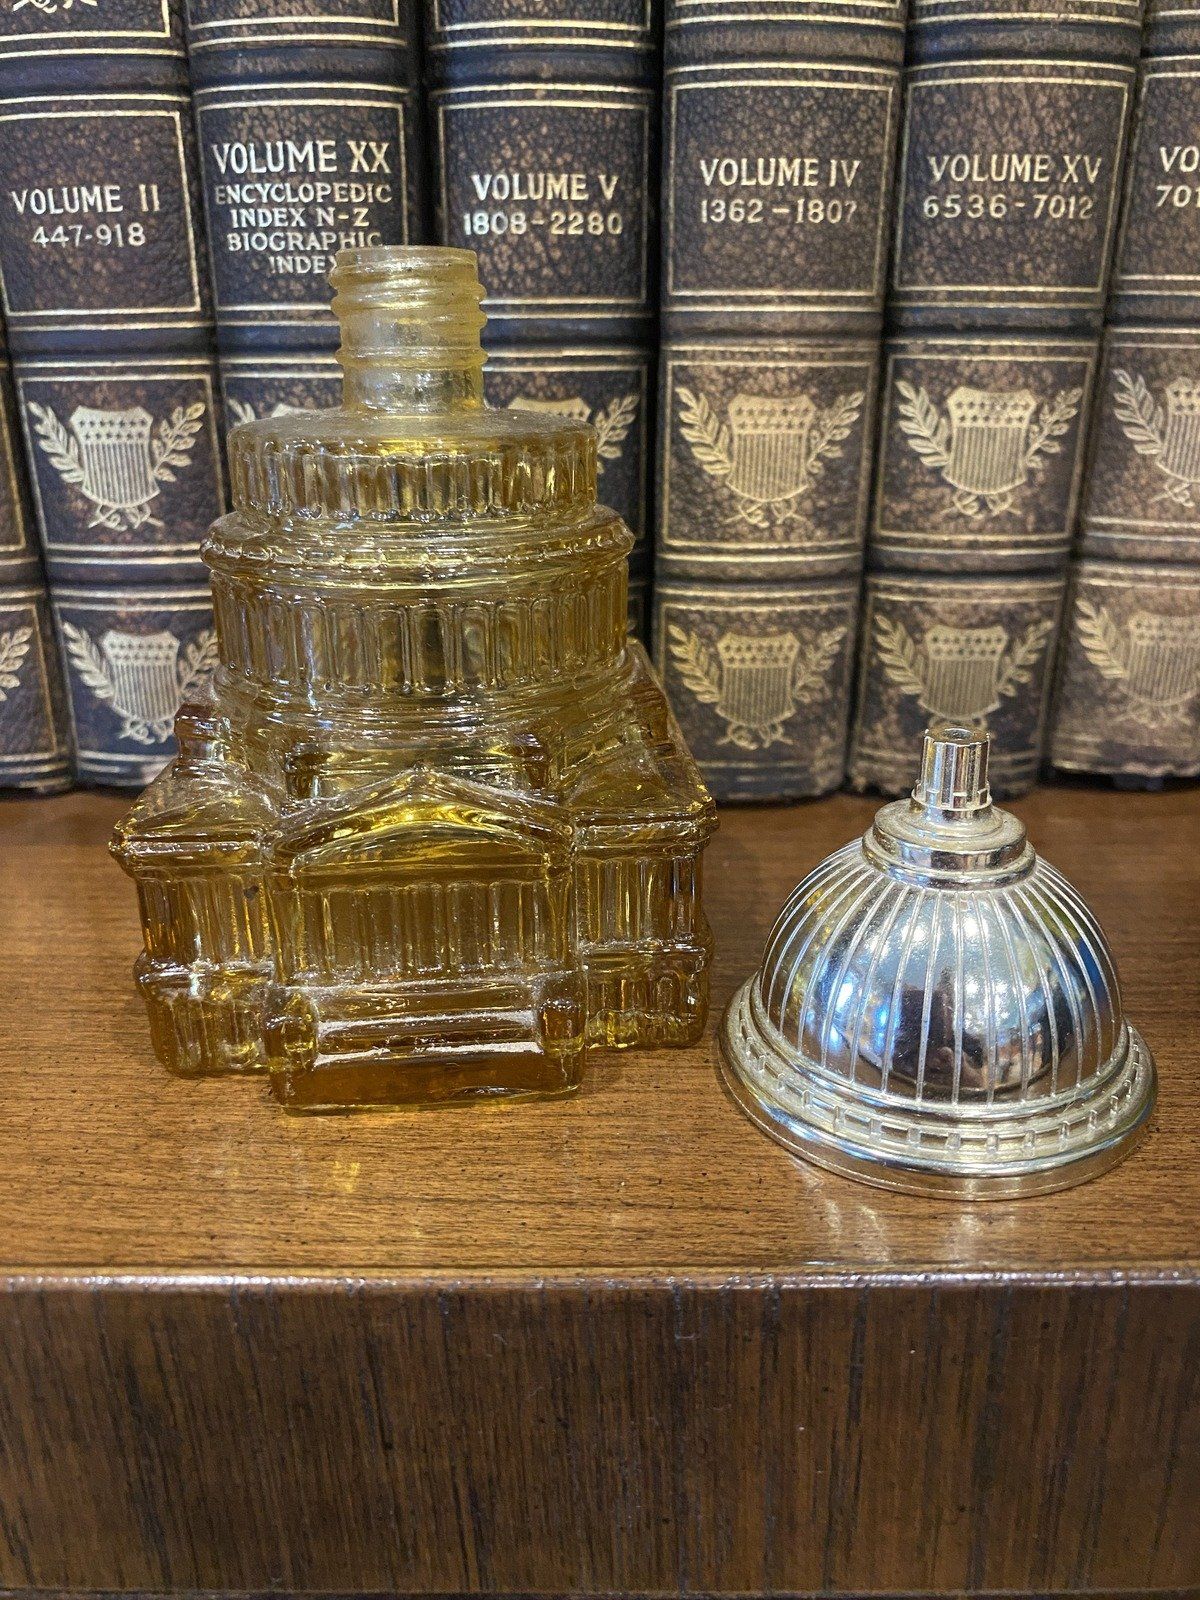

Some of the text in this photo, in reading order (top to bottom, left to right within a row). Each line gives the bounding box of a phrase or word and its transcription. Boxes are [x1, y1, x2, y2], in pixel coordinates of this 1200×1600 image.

[211, 140, 391, 175] VOLUME XX
[929, 154, 1102, 184] VOLUME XV
[700, 157, 861, 187] VOLUME IV
[12, 184, 160, 216] VOLUME II
[214, 182, 393, 205] ENCYCLOPEDIC
[471, 174, 620, 202] VOLUME V
[230, 206, 370, 229] INDEX N-Z
[922, 193, 1095, 220] 6536-7012
[32, 222, 146, 248] 447-918
[463, 211, 623, 236] 1808-2280
[226, 231, 383, 252] BIOGRAPHIC
